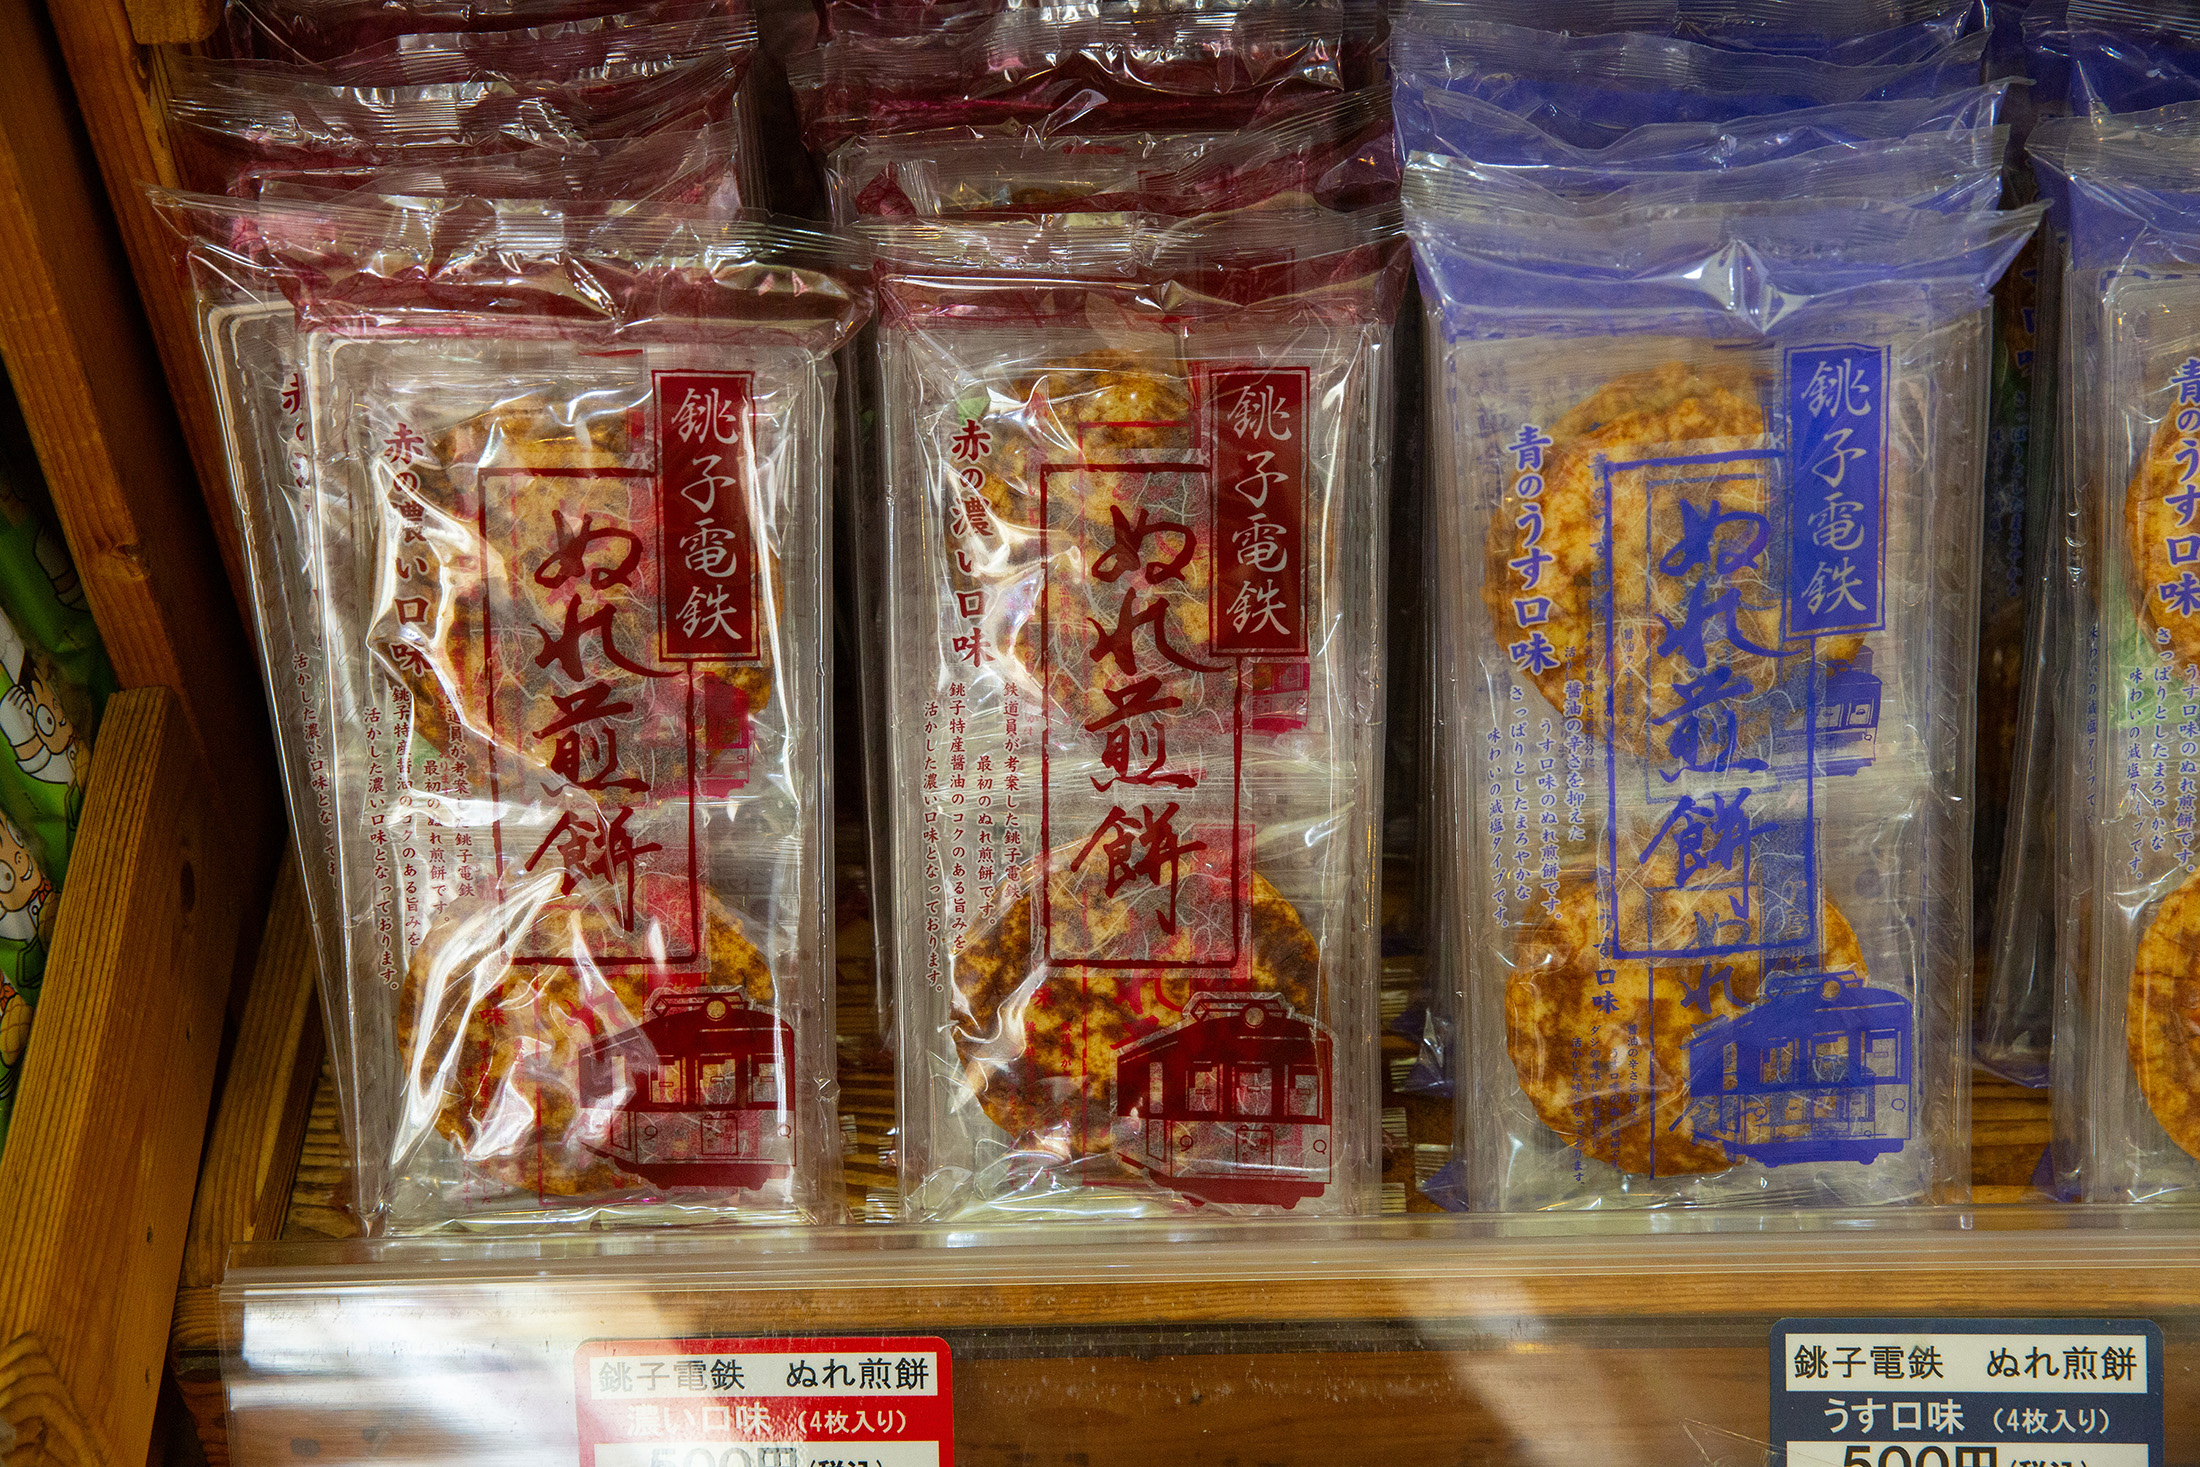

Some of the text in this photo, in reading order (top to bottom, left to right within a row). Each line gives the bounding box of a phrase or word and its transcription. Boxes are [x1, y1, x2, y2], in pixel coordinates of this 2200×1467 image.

[383, 423, 432, 675] 赤の濃い口味
[671, 388, 742, 641] 銚子電鉄
[1226, 385, 1291, 636] 銚子電鉄
[1509, 425, 1559, 673] 青のうす口味
[1801, 360, 1870, 614] 銚子電鉄
[2160, 358, 2200, 617] 青のうす口味
[524, 508, 686, 933] ぬれ煎餅
[950, 683, 968, 949] 銚子特産醤油のコクのある旨みを
[1003, 682, 1021, 899] 鉄道員が考案した銚子電鉄
[1070, 504, 1233, 935] ぬれ煎餅
[1511, 686, 1531, 900] さっぱりとしたまろやかな
[1538, 719, 1563, 920] うす口味のぬれ煎餅です。
[1566, 681, 1585, 841] 醤油の辛さを抑えた
[1640, 500, 1802, 917] ぬれ煎餅
[2127, 667, 2144, 880] 味わいの減塩タイプです。
[2151, 628, 2174, 851] さっぱりとしたまろやかな
[2176, 665, 2200, 873] うす口味のぬれ煎餅です。
[364, 708, 398, 990] 活かした濃い口味となっております。
[922, 702, 943, 993] 活かした濃い口味となっております。
[977, 756, 996, 925] 最初のぬれ煎餅です。
[1488, 727, 1508, 927] 味わいの減塩タイプです。
[599, 1357, 929, 1392] 銚子電鉄 ぬれ煎餅
[627, 1403, 907, 1437] 濃い口味 （4枚入り）
[1794, 1345, 2137, 1381] 銚子電鉄 ぬれ煎餅
[1824, 1398, 2110, 1434] うす口味 （4枚入り）
